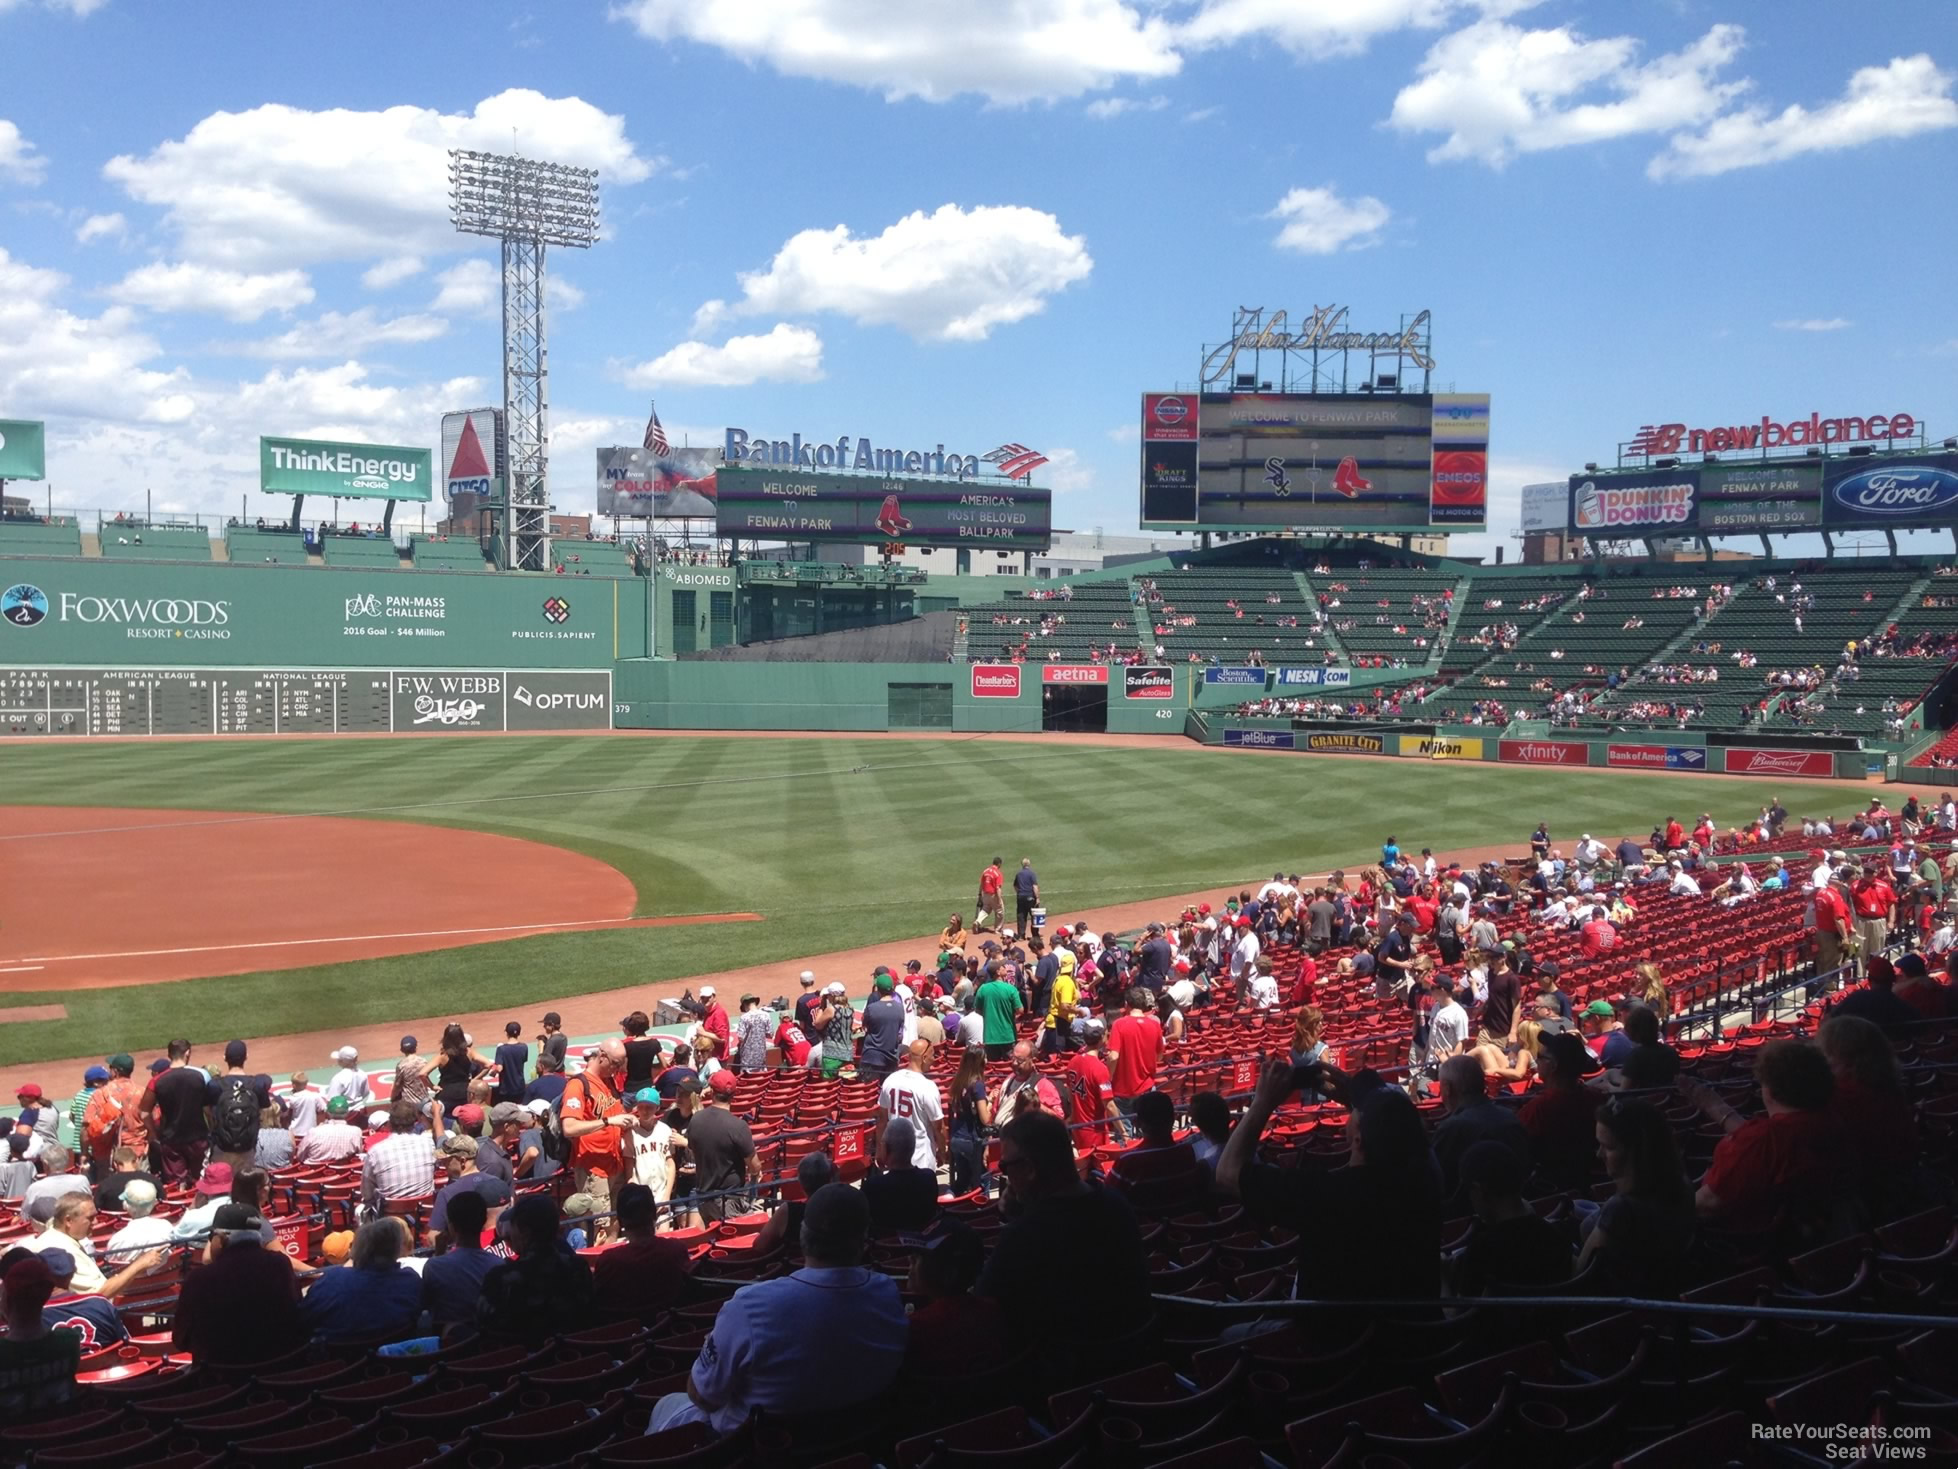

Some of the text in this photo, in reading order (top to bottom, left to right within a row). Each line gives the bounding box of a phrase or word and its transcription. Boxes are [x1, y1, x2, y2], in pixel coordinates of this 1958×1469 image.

[1200, 303, 1436, 383] John Hancock
[1229, 411, 1398, 422] WELCOME TO FENWAY PARK
[1688, 412, 1914, 451] new balance
[726, 427, 980, 478] Bank of America
[270, 447, 416, 482] ThinkEnergy
[606, 468, 628, 480] MY
[1436, 472, 1482, 483] ENEOS
[1727, 469, 1796, 482] WELCOME TO
[762, 482, 818, 496] WELCOME
[1721, 480, 1800, 494] FENWAY PARK
[1859, 474, 1938, 506] Ford
[960, 494, 1015, 508] AMERICA'S
[1607, 485, 1691, 508] DUNKIN'
[783, 500, 798, 512] TO
[1756, 502, 1772, 510] OF
[1776, 500, 1797, 510] THE
[948, 510, 1026, 524] MOST BELOVED
[1607, 504, 1687, 523] DONUTS
[1714, 512, 1805, 525] BOSTON RED SOX
[747, 515, 832, 531] FENWAY PARK
[959, 525, 1015, 539] BALLPARK
[884, 542, 906, 556] 2:05
[676, 574, 731, 586] ABIOMED
[59, 592, 229, 625] FOXWOODS
[386, 596, 446, 608] PAN-MASS
[386, 608, 446, 618] CHALLENGE
[126, 628, 231, 640] RESORT CASINO
[343, 626, 446, 638] 2016 Goal $46 Million
[512, 630, 596, 640] PUBLICIS.SAPIENT
[1052, 668, 1098, 681] aetna
[1216, 674, 1257, 683] Scientific
[1222, 668, 1249, 677] Boston
[1285, 670, 1319, 683] NESN
[397, 677, 500, 694] F.W. WEBB
[1126, 675, 1172, 686] Safelite
[1140, 688, 1171, 697] AutoGlass
[536, 694, 604, 709] OPTUM
[434, 698, 478, 724] 150
[615, 705, 630, 713] 379
[1155, 709, 1173, 720] 420
[1240, 731, 1276, 746] jetBlue
[1310, 735, 1382, 751] GRANITE CITY
[1419, 740, 1462, 755] Nikon
[1518, 744, 1567, 762] xfinity
[1609, 750, 1678, 762] Bank of America
[1754, 754, 1803, 768] Budweiser
[1887, 755, 1897, 767] 380
[1268, 986, 1277, 998] 24
[1237, 1072, 1251, 1083] 22
[889, 1088, 914, 1118] 15
[838, 1142, 857, 1155] 24
[275, 1226, 300, 1235] IELD
